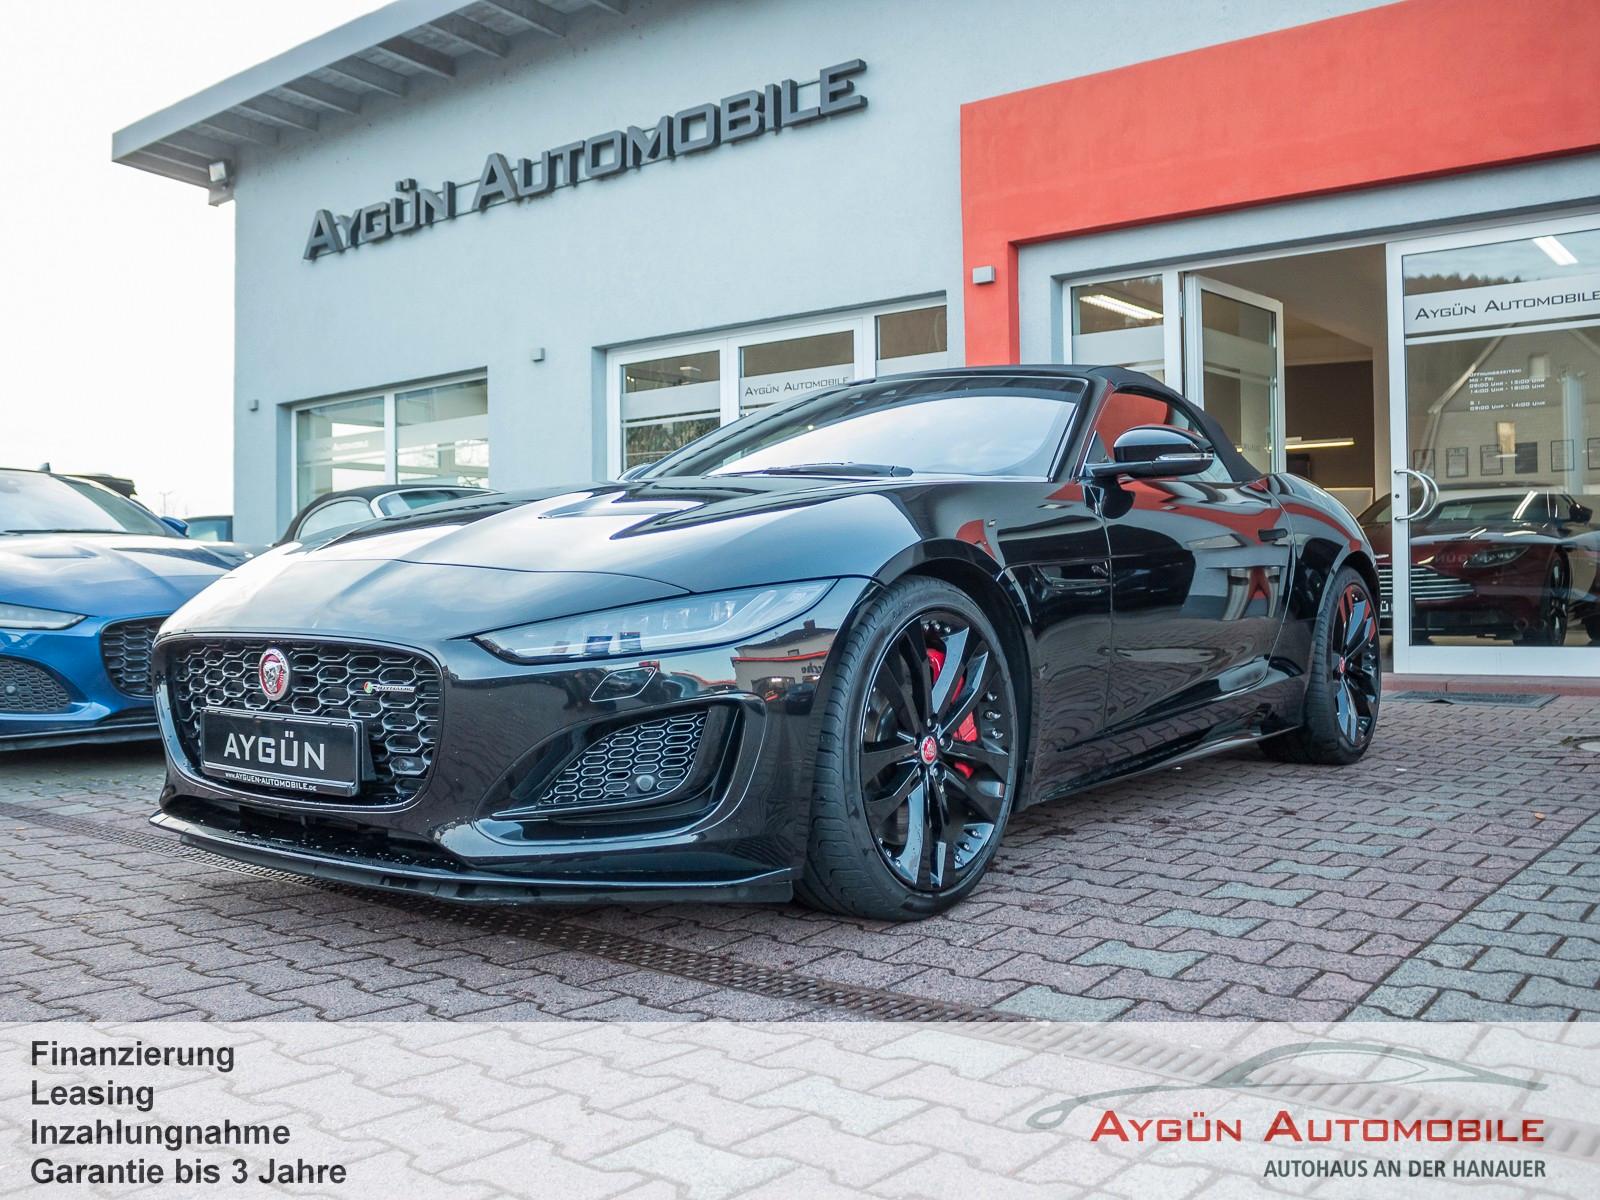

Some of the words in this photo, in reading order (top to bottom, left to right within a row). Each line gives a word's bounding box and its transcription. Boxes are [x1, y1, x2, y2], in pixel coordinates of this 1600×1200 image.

[303, 178, 456, 260] AYGÜN
[472, 58, 868, 211] AUTOMOBILE
[1415, 303, 1476, 320] AYGÜN
[1485, 290, 1600, 312] AUTOMOBILE
[744, 383, 779, 397] AYGÜN
[784, 376, 849, 392] AUTOMOBILE
[224, 731, 325, 771] AYGÜN
